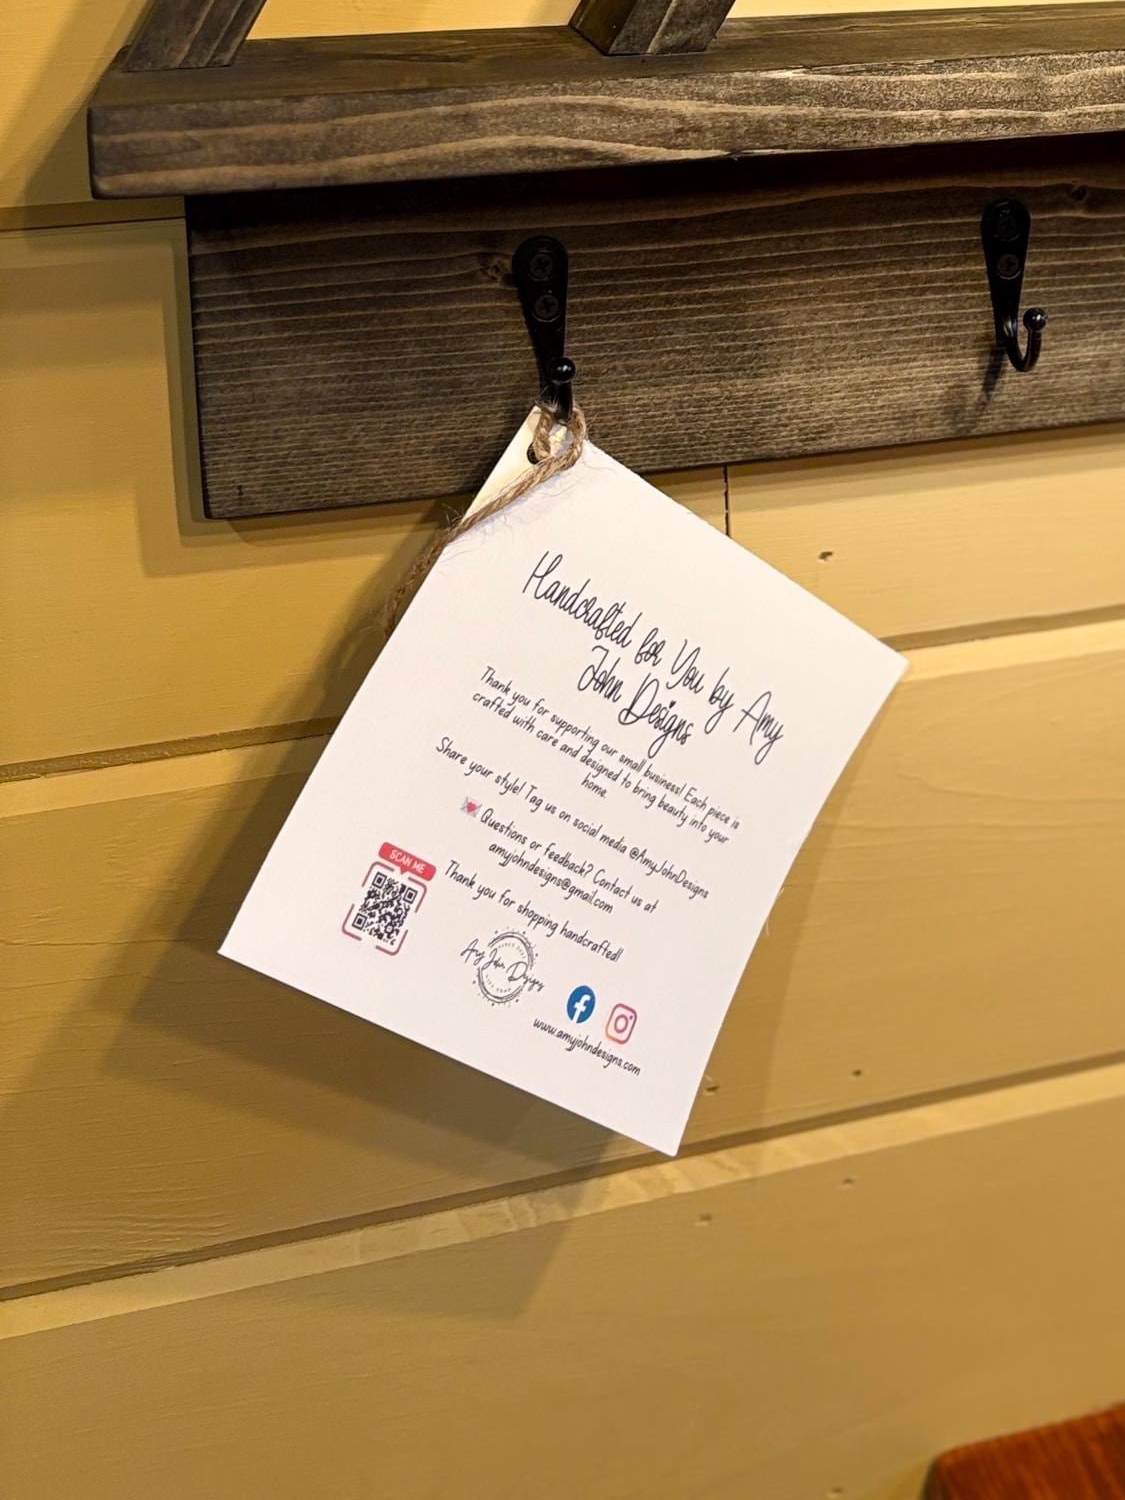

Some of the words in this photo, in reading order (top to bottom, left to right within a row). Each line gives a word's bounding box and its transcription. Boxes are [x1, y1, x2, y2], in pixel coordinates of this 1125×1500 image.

[521, 550, 643, 649] Handcrafted
[633, 627, 667, 675] for
[657, 638, 705, 695] You
[703, 666, 735, 736] by
[732, 690, 784, 766] Amy
[576, 644, 640, 704] John
[617, 672, 695, 760] Designs
[472, 692, 517, 720] crafted
[511, 714, 537, 734] with
[535, 729, 563, 747] care
[559, 743, 584, 759] and
[579, 751, 624, 782] designed
[620, 771, 632, 789] to
[631, 778, 658, 810] bring
[656, 793, 689, 828] beauty
[688, 818, 708, 833] into
[703, 828, 730, 844] your
[480, 665, 513, 696] Thank
[506, 691, 532, 710] you
[531, 697, 550, 717] for
[550, 714, 601, 754] supporting
[600, 743, 619, 757] our
[617, 754, 648, 773] small
[642, 763, 688, 797] business!
[683, 786, 709, 812] Each
[701, 806, 731, 825] piece
[730, 819, 740, 830] is
[580, 772, 607, 799] home.
[387, 848, 415, 870] SCAN
[410, 859, 428, 876] ME
[435, 736, 468, 765] Share
[463, 761, 494, 779] your
[494, 771, 528, 796] style!
[524, 784, 544, 814] Tag
[544, 802, 558, 815] us
[558, 810, 572, 823] on
[572, 818, 604, 838] social
[598, 833, 628, 854] media
[628, 846, 710, 900] @AmyJohnDesigns
[480, 807, 529, 845] Questions
[529, 840, 543, 852] or
[542, 842, 595, 879] feedback?
[592, 868, 634, 900] Contact
[630, 895, 643, 907] us
[643, 899, 660, 914] at
[444, 859, 478, 890] Thank
[471, 884, 497, 901] you
[497, 888, 517, 908] for
[516, 899, 559, 938] shopping
[559, 920, 625, 963] handcrafted!
[488, 843, 614, 914] amyjohndesigns@gmail.com
[532, 1018, 641, 1077] www.amyjohndesigns.com
